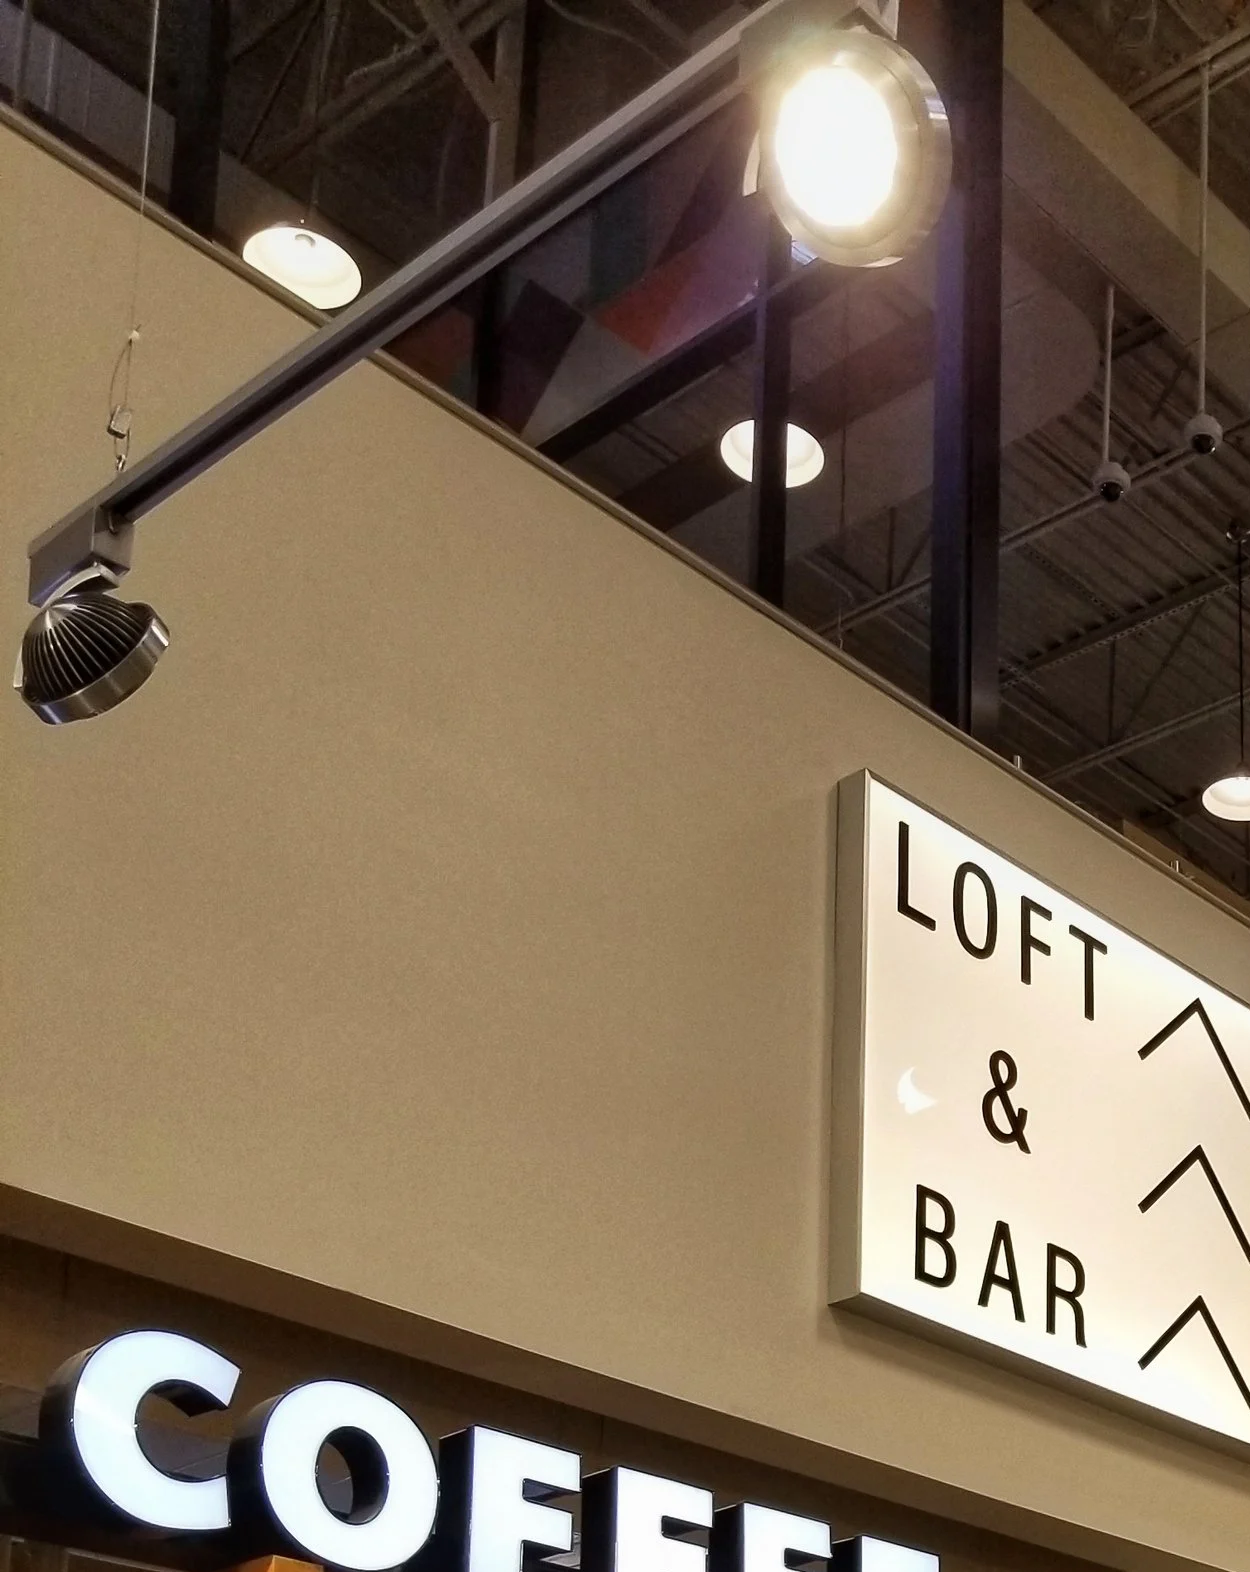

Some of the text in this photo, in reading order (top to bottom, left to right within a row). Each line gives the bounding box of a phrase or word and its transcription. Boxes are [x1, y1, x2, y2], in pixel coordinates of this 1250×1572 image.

[897, 821, 1108, 1021] LOFT
[981, 1050, 1031, 1154] &
[914, 1184, 1087, 1348] BAR
